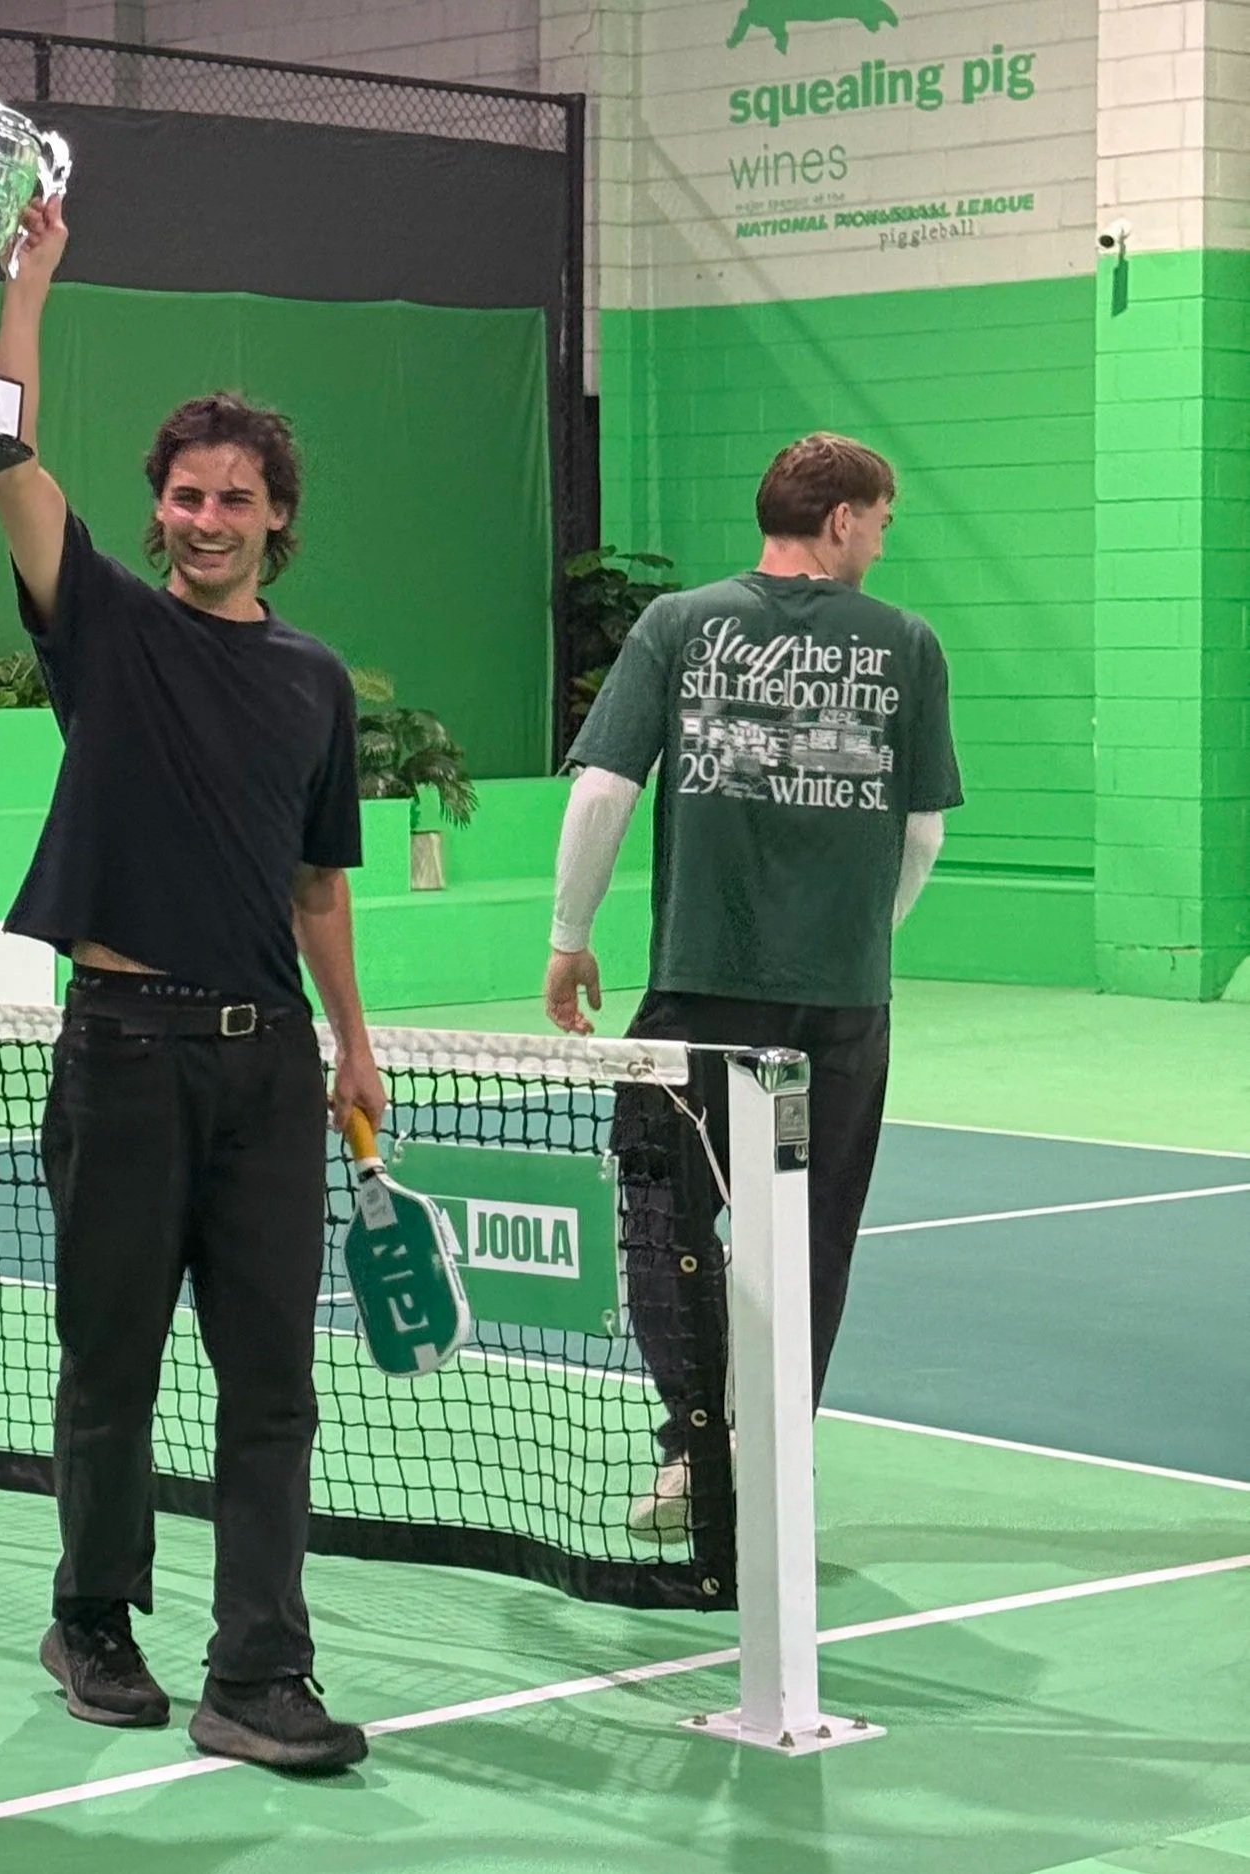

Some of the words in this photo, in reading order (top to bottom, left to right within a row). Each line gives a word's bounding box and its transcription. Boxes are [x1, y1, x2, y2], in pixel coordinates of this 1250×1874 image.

[729, 59, 944, 127] squealing
[961, 44, 1036, 104] pig
[729, 144, 847, 190] wines
[735, 214, 829, 238] NATIONAL
[955, 193, 1035, 217] LEAGUE
[879, 219, 975, 251] piggleball
[791, 635, 842, 673] the
[845, 634, 892, 683] jar
[678, 753, 720, 795] 29
[768, 765, 854, 808] white
[475, 1211, 574, 1266] JOOLA
